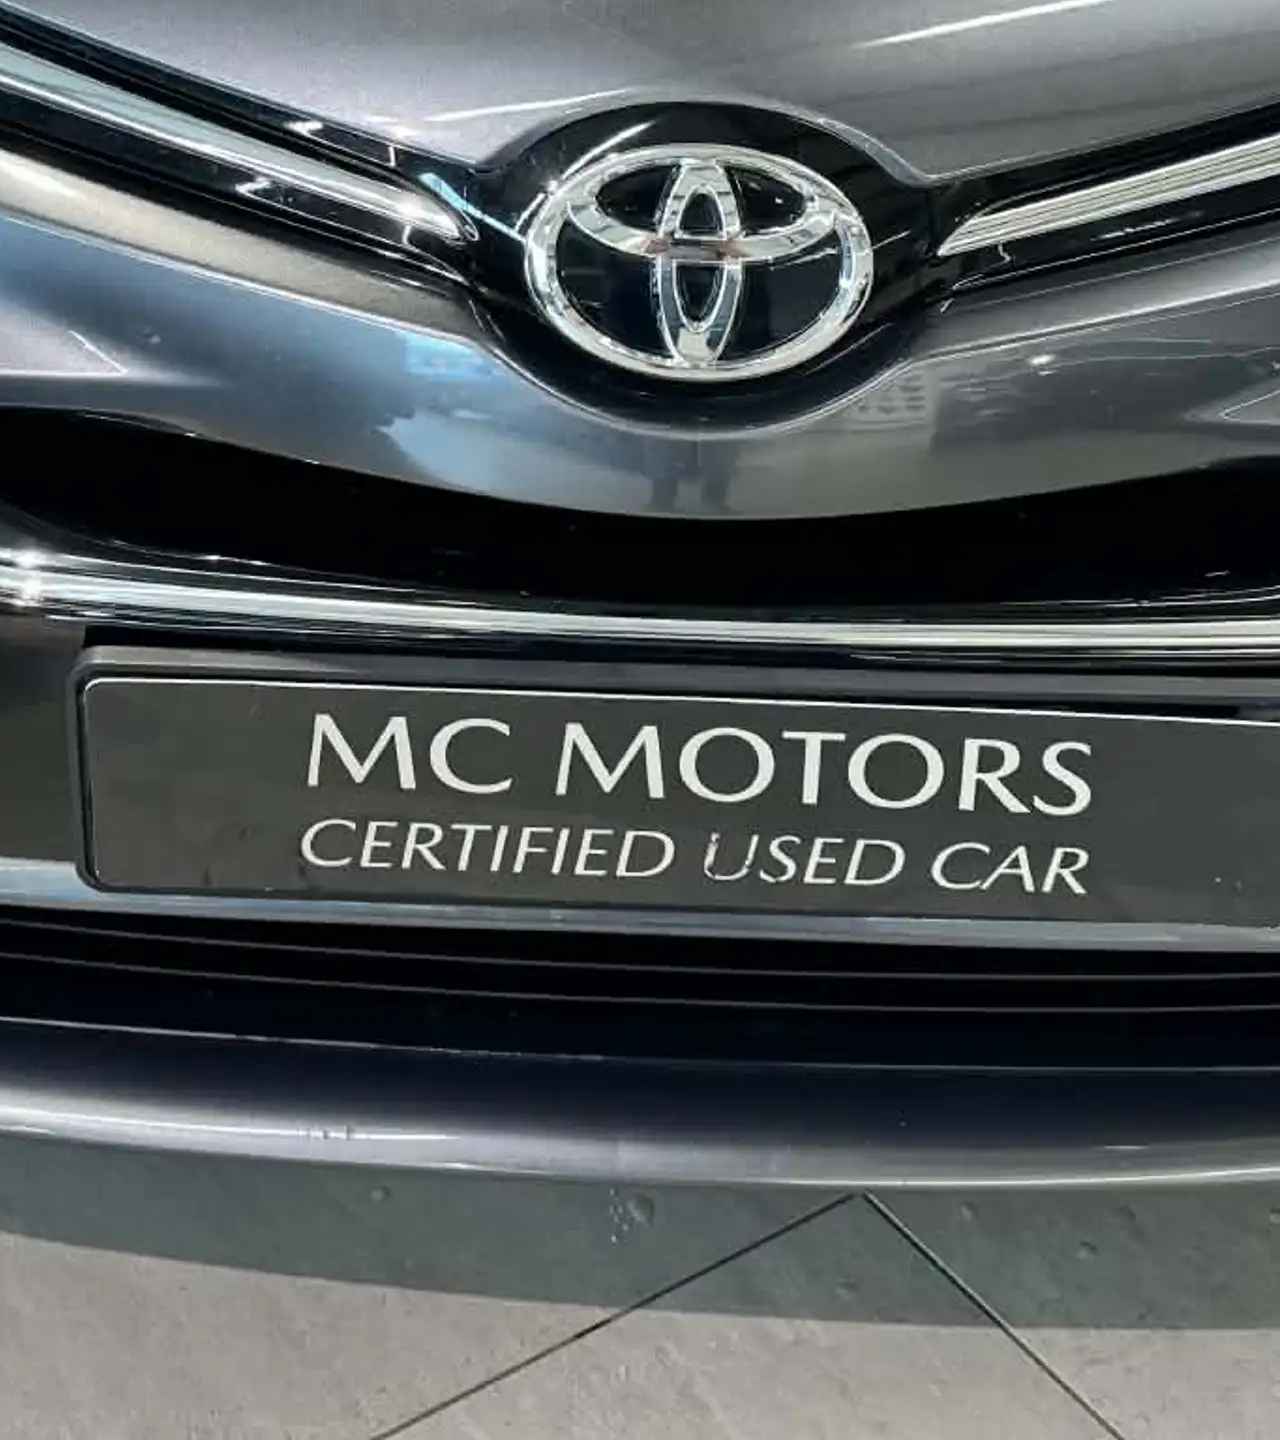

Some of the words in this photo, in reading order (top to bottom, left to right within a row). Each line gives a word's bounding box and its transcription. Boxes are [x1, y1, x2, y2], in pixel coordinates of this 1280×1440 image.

[307, 713, 513, 795] MC
[555, 722, 1092, 816] MOTORS
[300, 818, 676, 878] CERTIFIED
[703, 832, 907, 887] USED
[930, 841, 1090, 895] CAR
